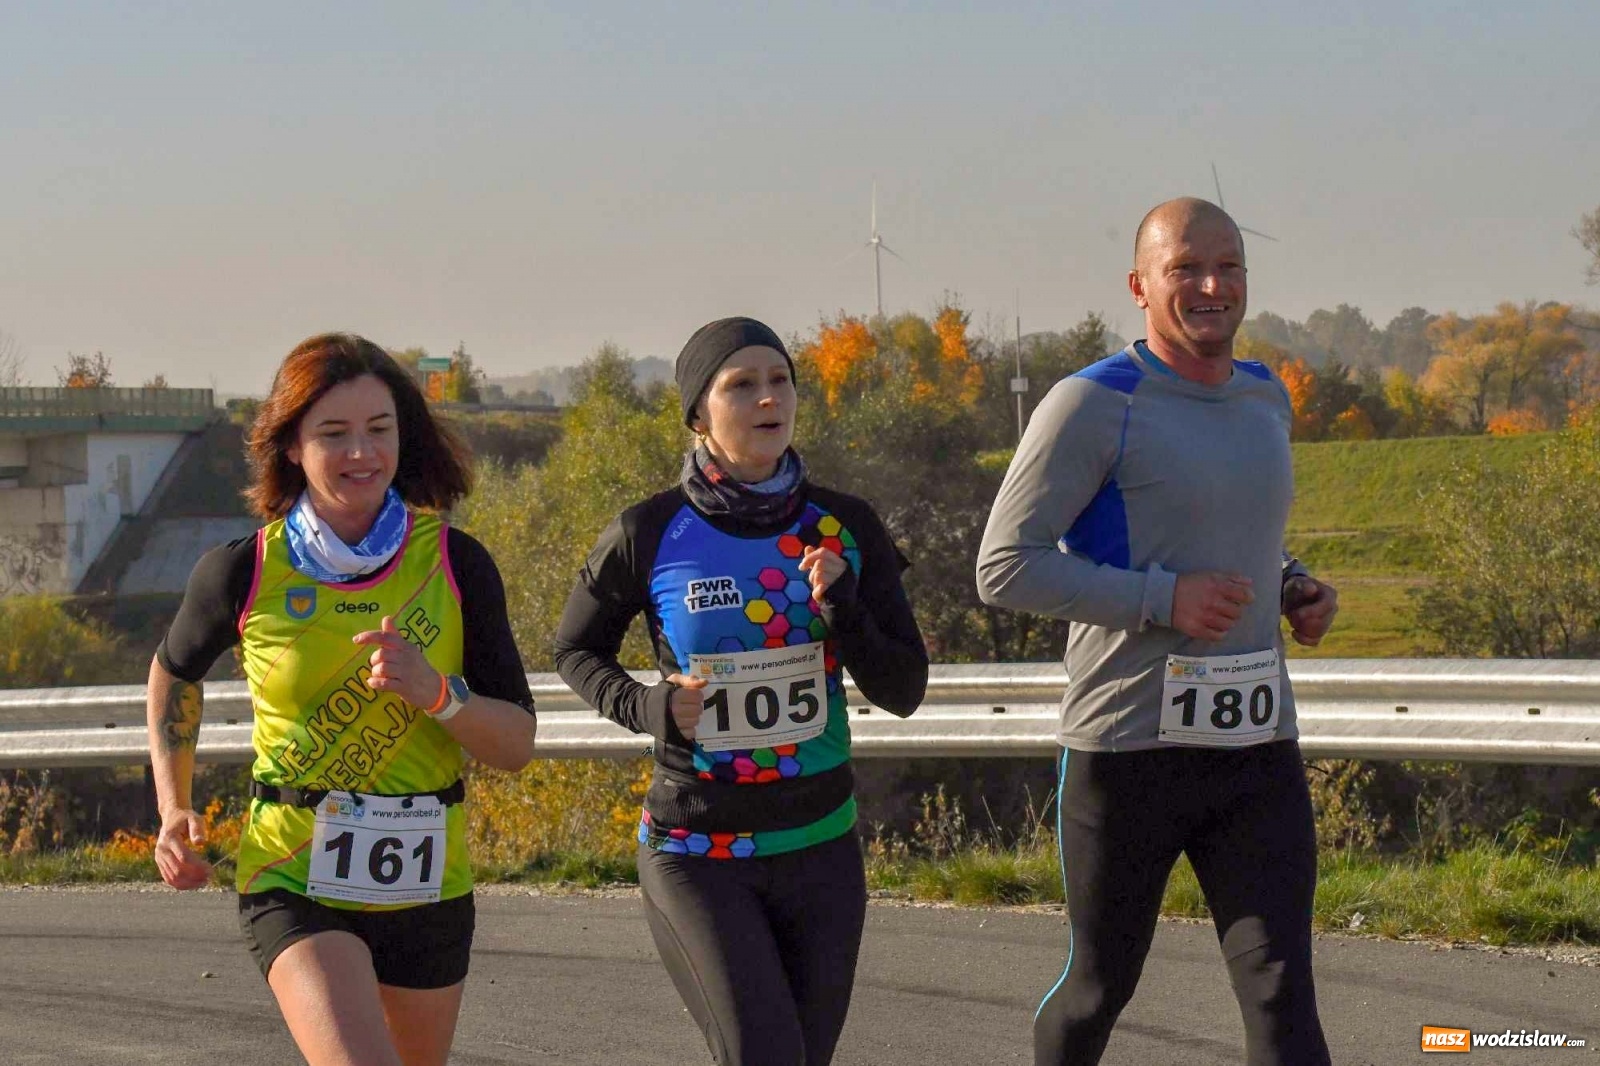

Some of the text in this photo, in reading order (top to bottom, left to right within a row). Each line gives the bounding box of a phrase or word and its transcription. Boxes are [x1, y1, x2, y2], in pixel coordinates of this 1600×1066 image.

[691, 578, 733, 595] PWR
[335, 600, 380, 614] deep
[688, 592, 740, 611] TEAM
[741, 653, 816, 671] www.personalbest.pl
[704, 678, 819, 731] 105
[1172, 684, 1274, 729] 180
[372, 808, 442, 818] www.personalbest.pl
[325, 831, 434, 885] 161
